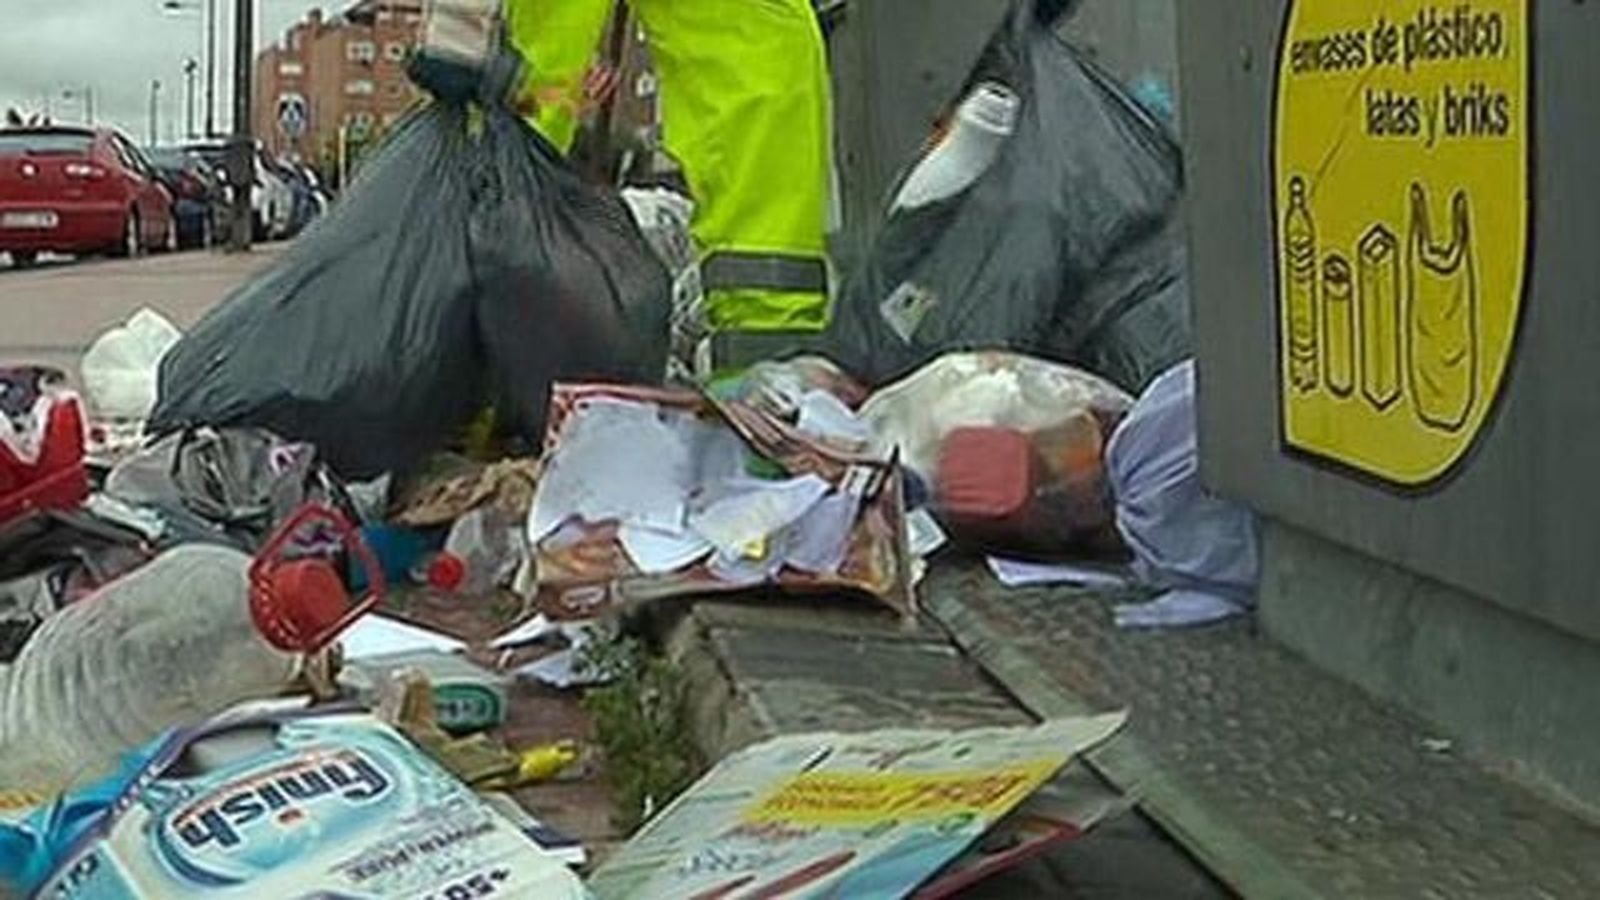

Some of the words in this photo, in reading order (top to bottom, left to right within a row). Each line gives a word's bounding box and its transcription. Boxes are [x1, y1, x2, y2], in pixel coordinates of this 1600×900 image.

[1372, 17, 1398, 63] de
[1366, 88, 1420, 136] latas
[1425, 94, 1439, 148] y
[1444, 82, 1508, 136] briks
